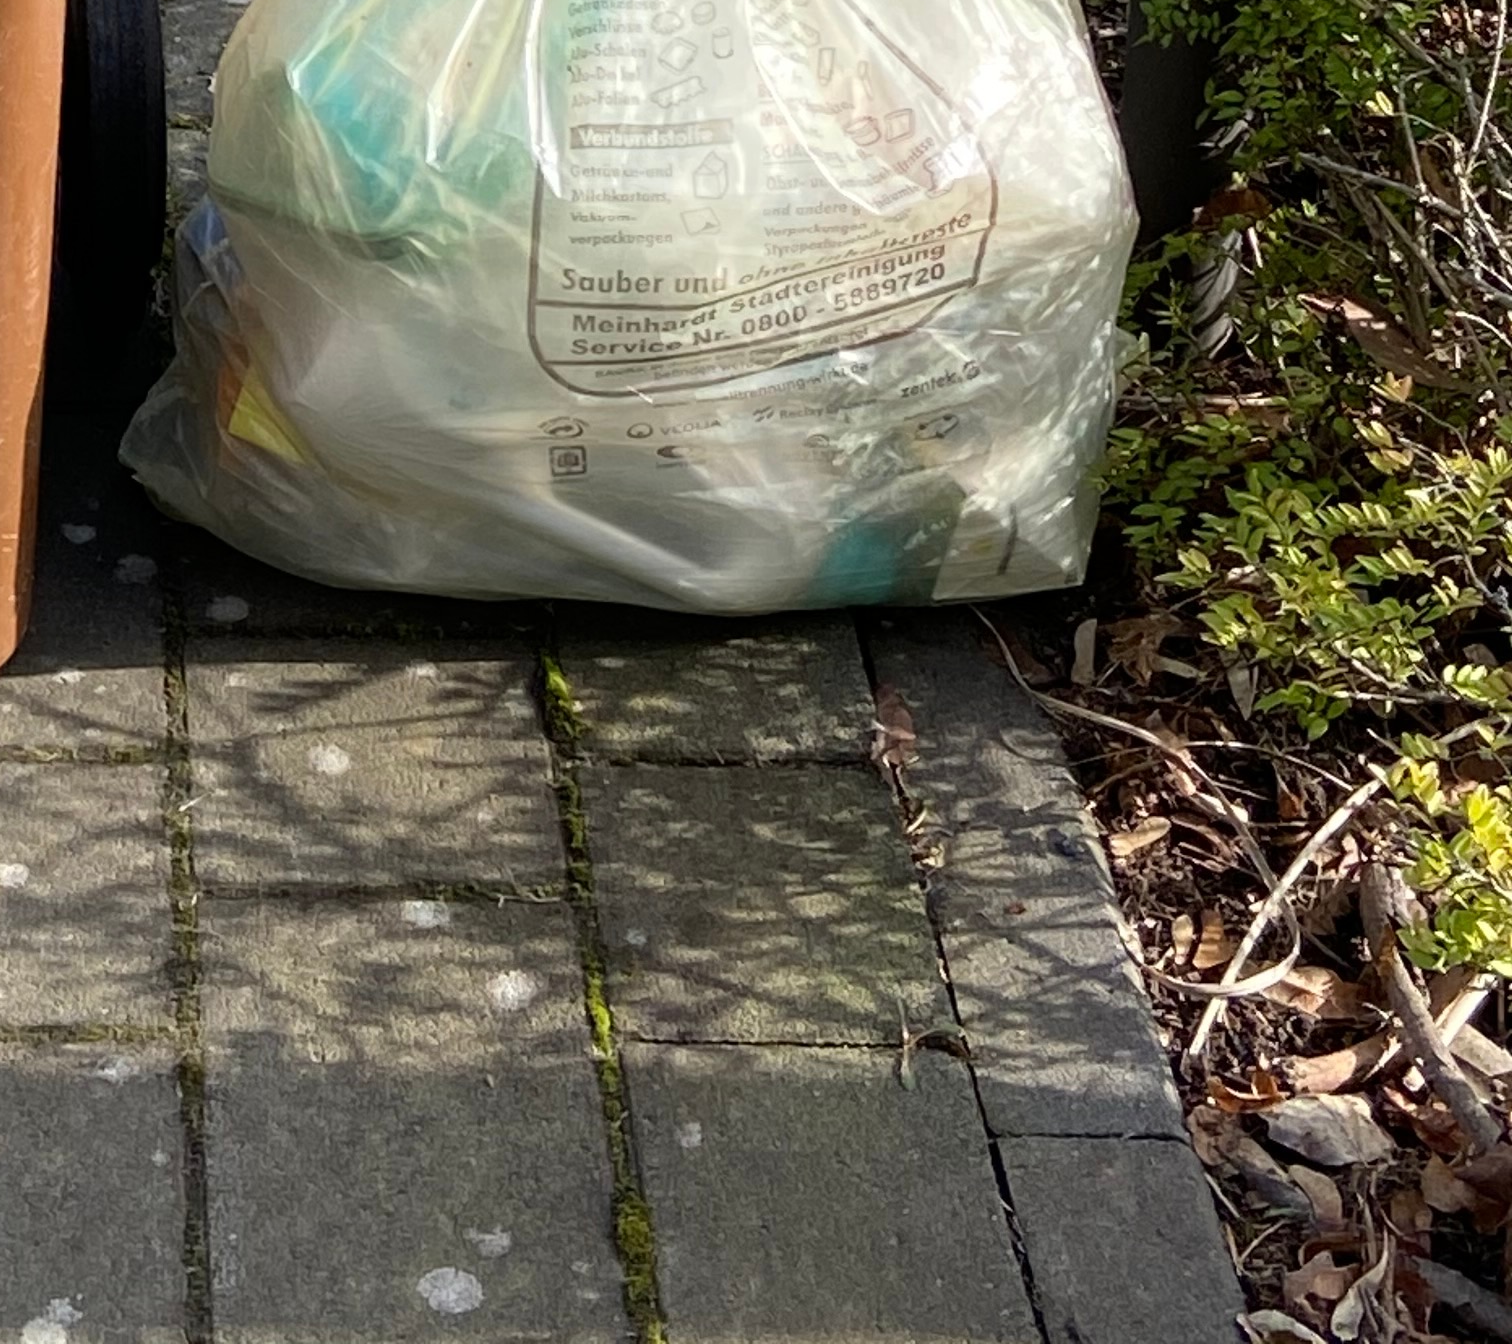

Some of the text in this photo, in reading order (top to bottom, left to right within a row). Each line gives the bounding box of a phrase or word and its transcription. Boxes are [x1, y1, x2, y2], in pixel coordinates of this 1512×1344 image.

[578, 127, 714, 150] Verbundstoffe
[561, 268, 664, 295] Sauber
[674, 267, 728, 294] und
[570, 338, 683, 355] Service
[691, 328, 732, 346] Nr.
[740, 305, 808, 335] 0800
[833, 262, 946, 312] 5889720
[572, 308, 718, 333] Meinhardt
